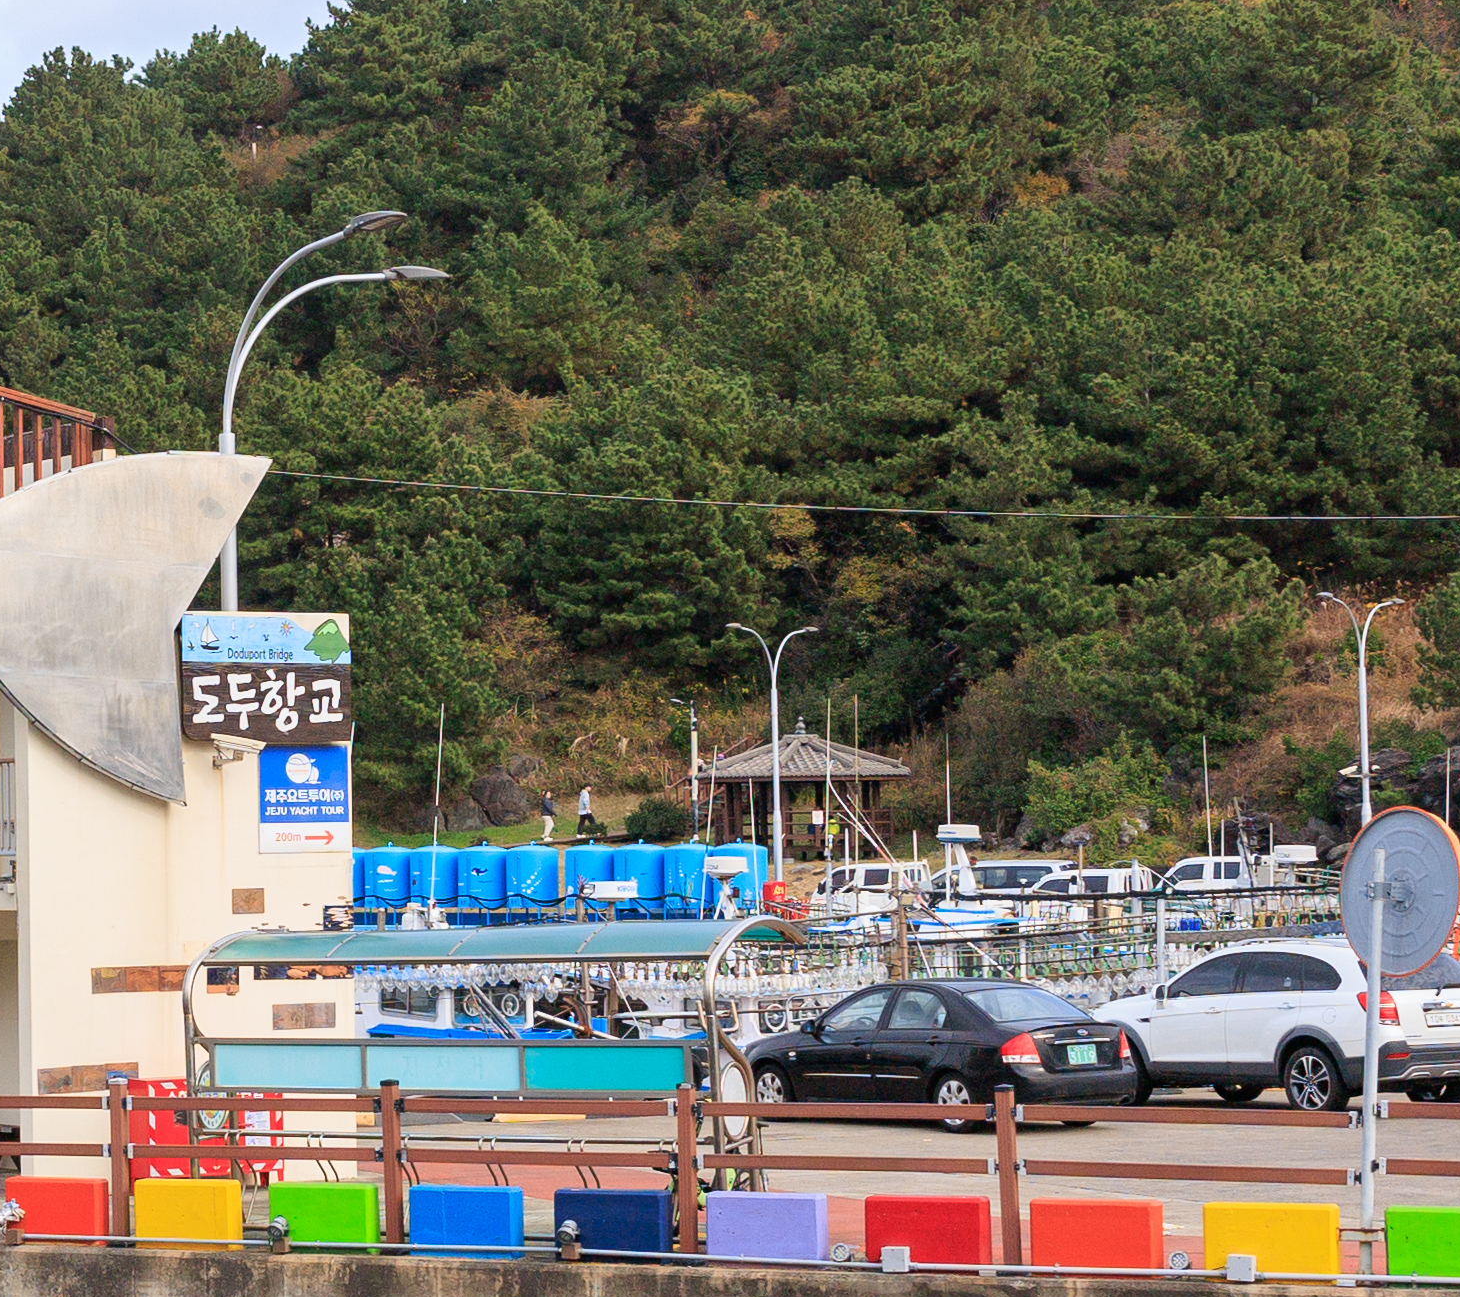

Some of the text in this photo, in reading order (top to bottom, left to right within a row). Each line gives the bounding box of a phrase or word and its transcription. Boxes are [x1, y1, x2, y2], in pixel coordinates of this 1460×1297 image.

[227, 647, 294, 662] Doduport Bridge
[264, 805, 345, 816] JEJU YACHT TOUR
[275, 832, 302, 842] 200m
